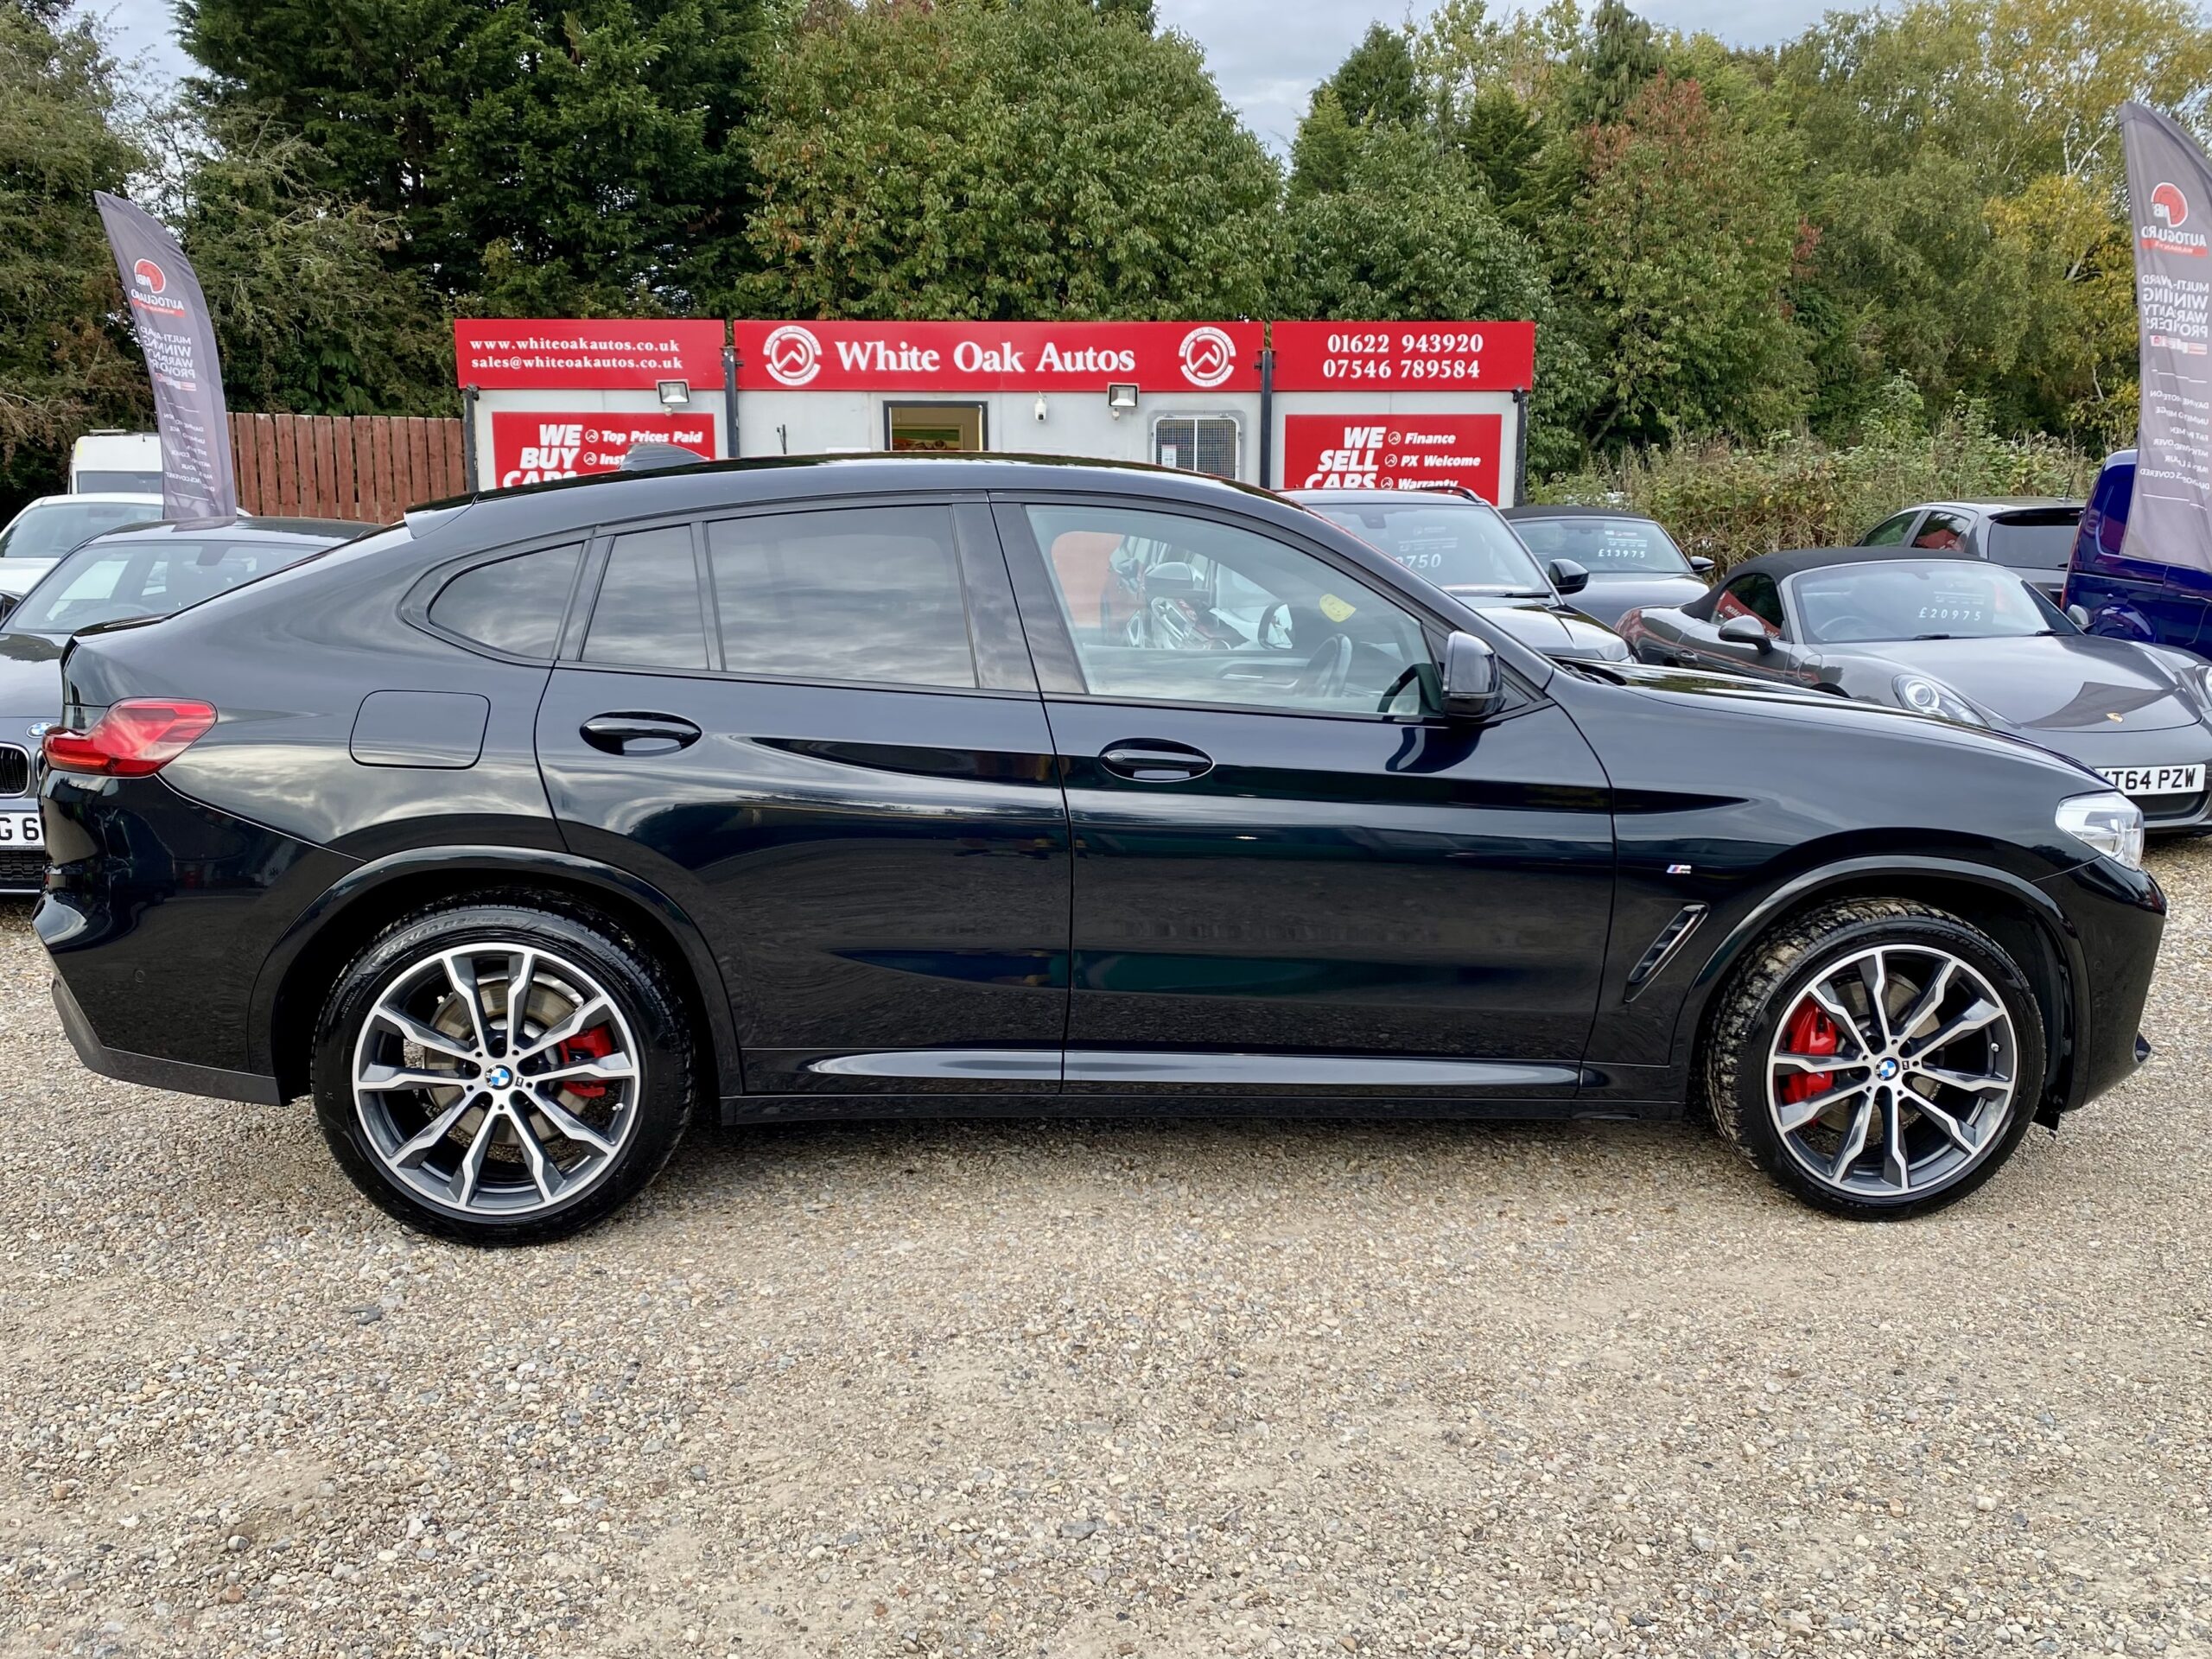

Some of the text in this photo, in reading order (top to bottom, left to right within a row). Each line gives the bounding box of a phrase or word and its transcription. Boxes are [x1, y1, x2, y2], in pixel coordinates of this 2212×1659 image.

[469, 337, 681, 353] www.whiteoakautos.co.uk
[1327, 334, 1484, 353] 01622 943920
[471, 355, 683, 371] sales@whiteoakautos.co.uk
[834, 340, 941, 373] White
[953, 340, 1027, 373] Oak
[1034, 341, 1136, 373] Autos
[1322, 359, 1480, 379] 07546 789584
[538, 424, 583, 446] WE
[601, 430, 703, 444] Top Prices Paid
[1344, 427, 1387, 448] WE
[1404, 432, 1457, 445] Finance
[518, 447, 581, 469] BUY
[599, 453, 626, 466] Inst
[1317, 449, 1379, 472] SELL
[1400, 454, 1482, 467] PX Welcome
[502, 471, 578, 488] CA
[1304, 473, 1377, 490] CARS
[1398, 478, 1459, 491] Warranty
[1598, 549, 1646, 558] £13975
[1918, 607, 1982, 621] £20975
[2158, 767, 2196, 789] PZW
